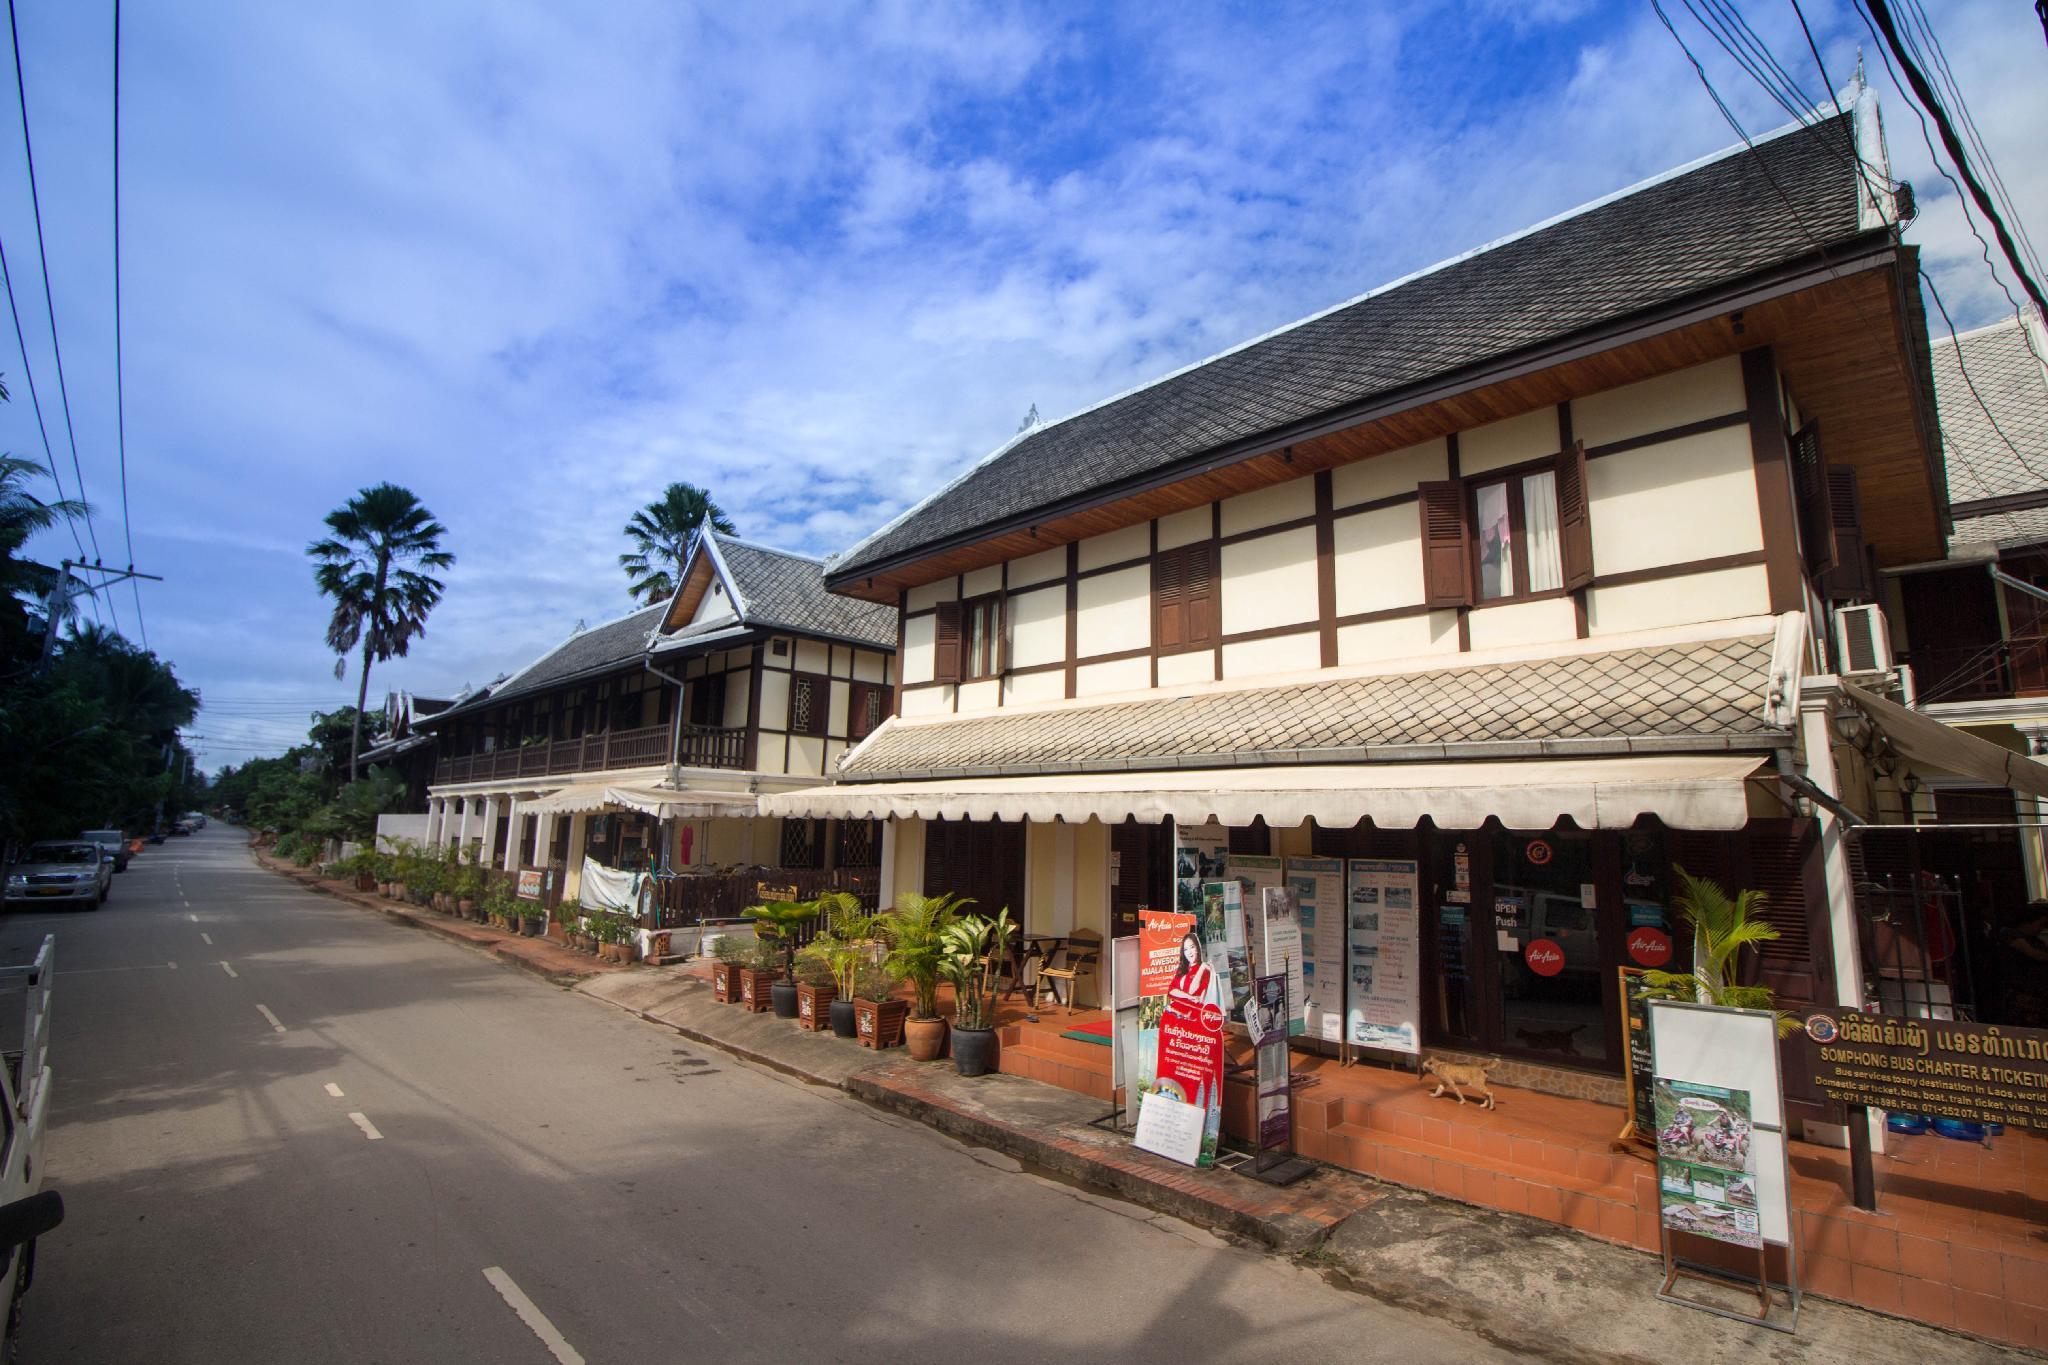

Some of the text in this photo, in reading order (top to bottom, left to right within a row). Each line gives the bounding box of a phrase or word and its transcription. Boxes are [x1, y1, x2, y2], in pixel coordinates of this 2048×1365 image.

[1495, 903, 1517, 914] OPEN
[1495, 915, 1517, 927] Push
[1821, 1047, 1888, 1068] SOMPHONG
[1890, 1056, 1915, 1071] BUS
[1916, 1059, 1979, 1080] CHARTER
[1981, 1066, 1991, 1081] &
[1815, 1076, 1857, 1090] Domestic
[1858, 1083, 1871, 1092] air
[1949, 1095, 1973, 1106] train
[1834, 1067, 1853, 1077] Bus
[1854, 1070, 1891, 1082] services
[1919, 1078, 1974, 1093] destination
[1975, 1084, 1985, 1094] in
[1843, 1092, 1859, 1102] 071
[1983, 1111, 2004, 1123] Ban
